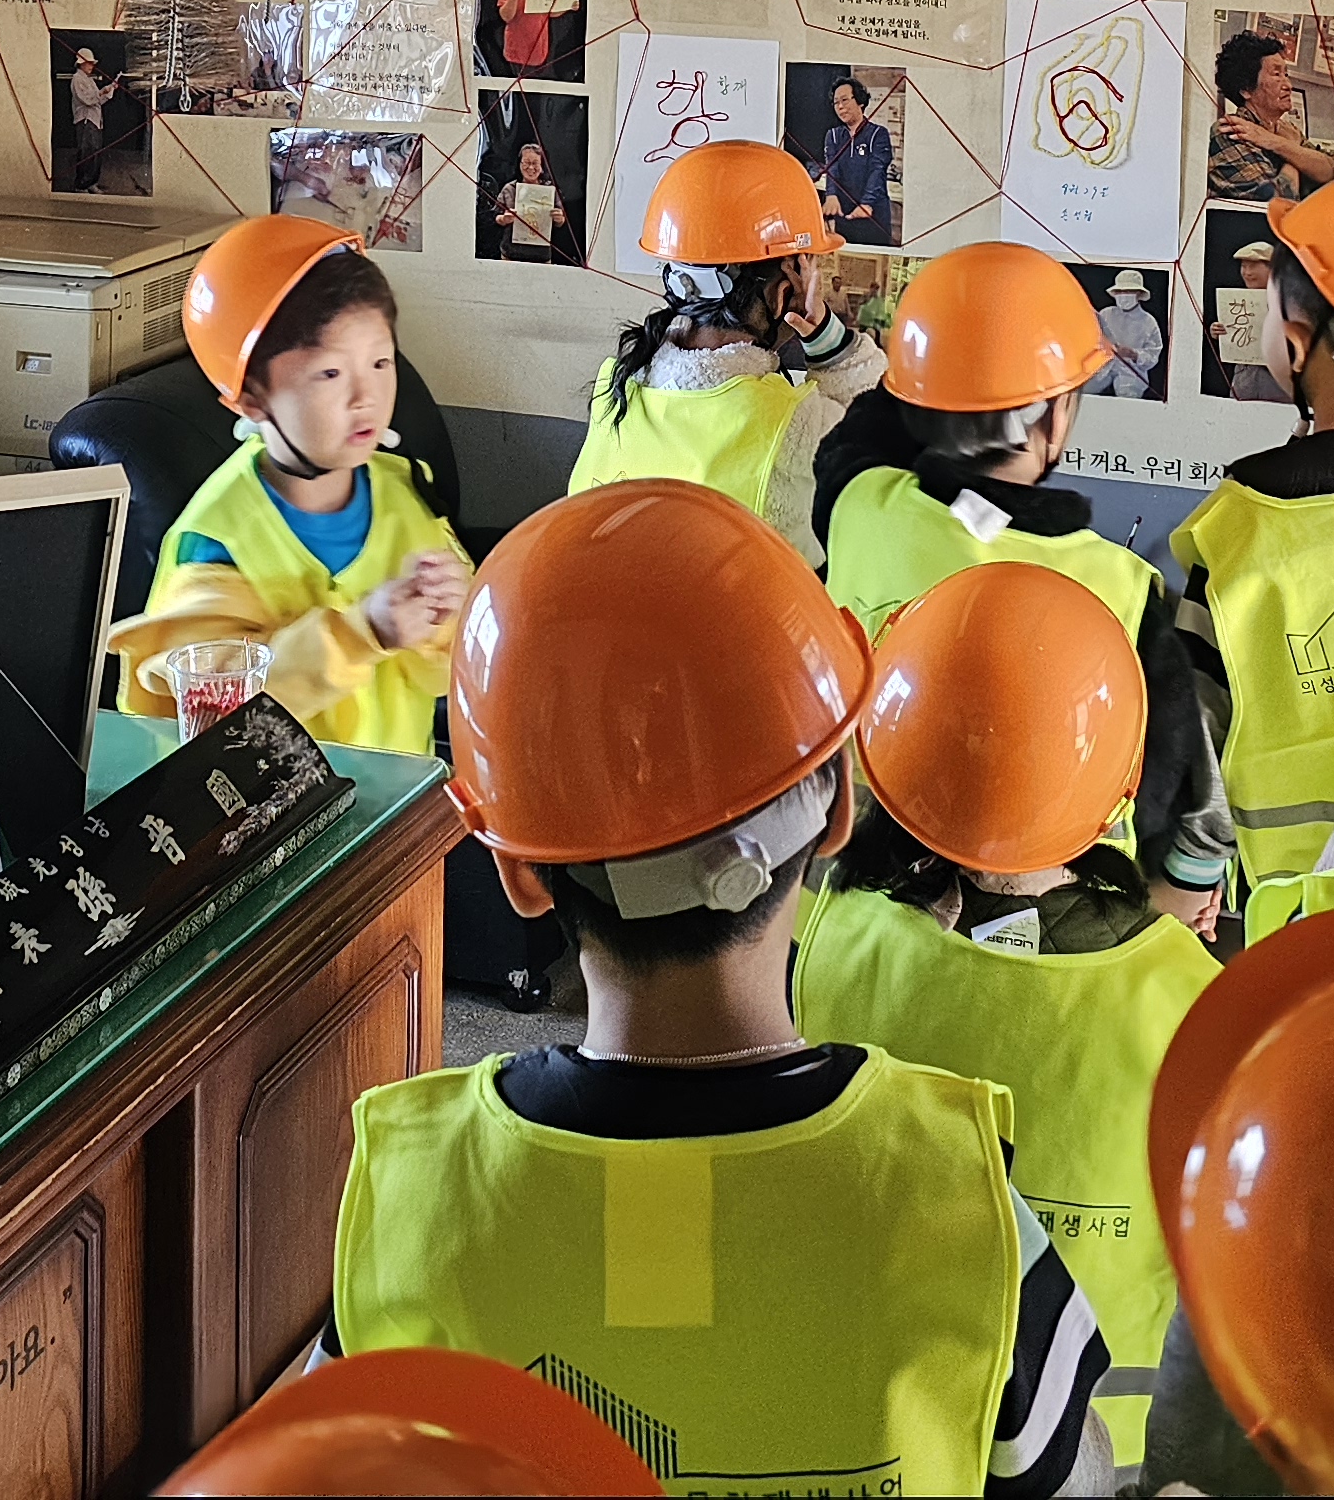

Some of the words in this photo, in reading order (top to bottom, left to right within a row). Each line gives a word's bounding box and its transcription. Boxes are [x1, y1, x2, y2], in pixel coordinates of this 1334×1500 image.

[837, 15, 845, 24] 내
[849, 16, 857, 25] 삶
[901, 30, 929, 40] 됩니다.
[1064, 448, 1086, 471] 다
[1141, 456, 1182, 482] 우리
